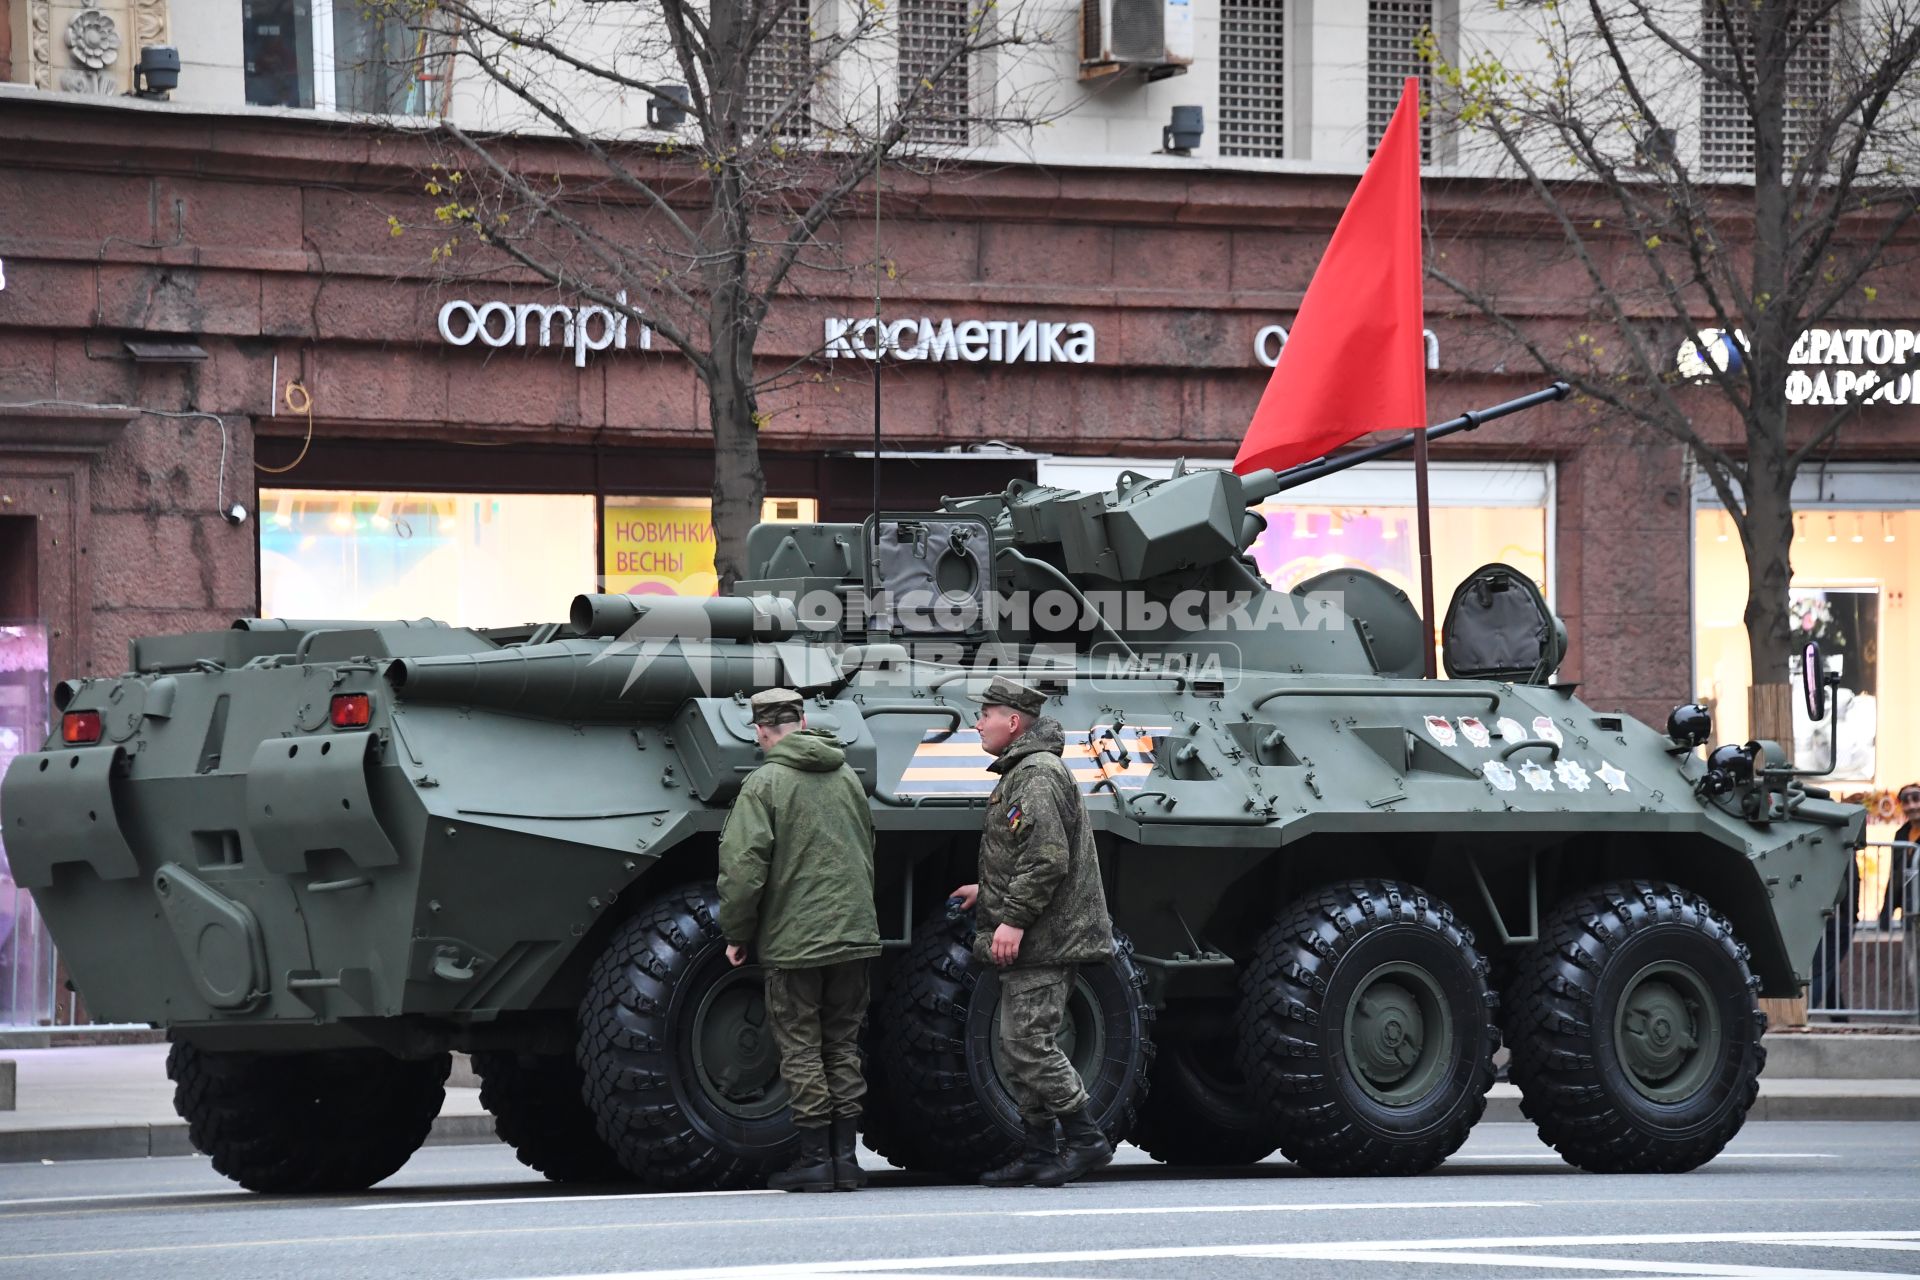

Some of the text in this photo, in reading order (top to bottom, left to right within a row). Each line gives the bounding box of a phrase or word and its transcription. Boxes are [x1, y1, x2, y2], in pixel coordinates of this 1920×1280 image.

[438, 289, 651, 367] oomph
[824, 317, 1096, 364] косметика
[616, 521, 714, 543] НОВИНКИ
[617, 551, 684, 572] ВЕСНЫ
